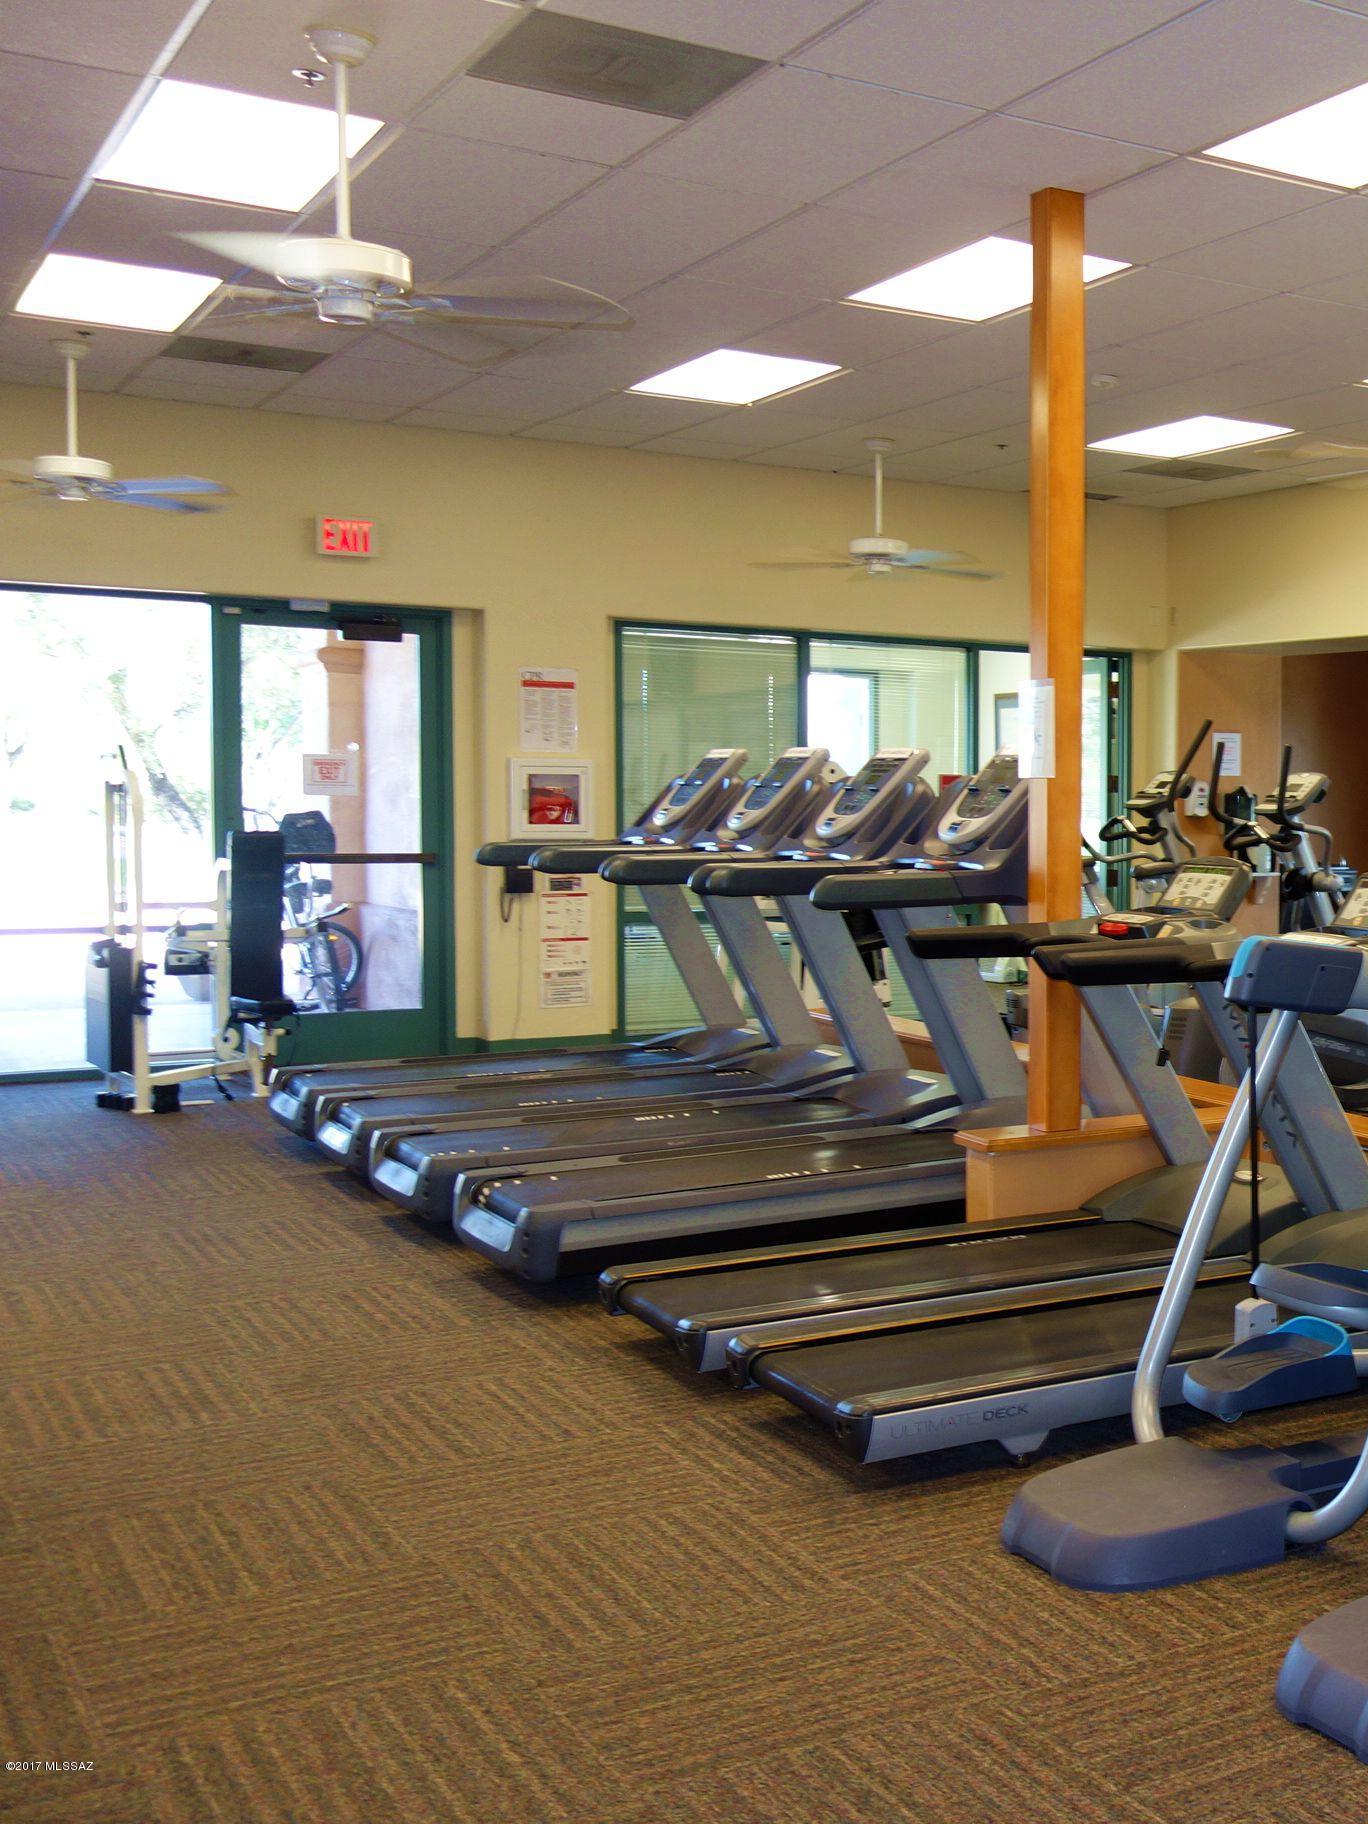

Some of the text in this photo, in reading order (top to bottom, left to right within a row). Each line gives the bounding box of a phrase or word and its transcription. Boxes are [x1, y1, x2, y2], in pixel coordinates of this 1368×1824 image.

[322, 517, 375, 553] EXIT
[319, 766, 341, 775] EXIT
[889, 1404, 1030, 1440] ULTIMATE DECK
